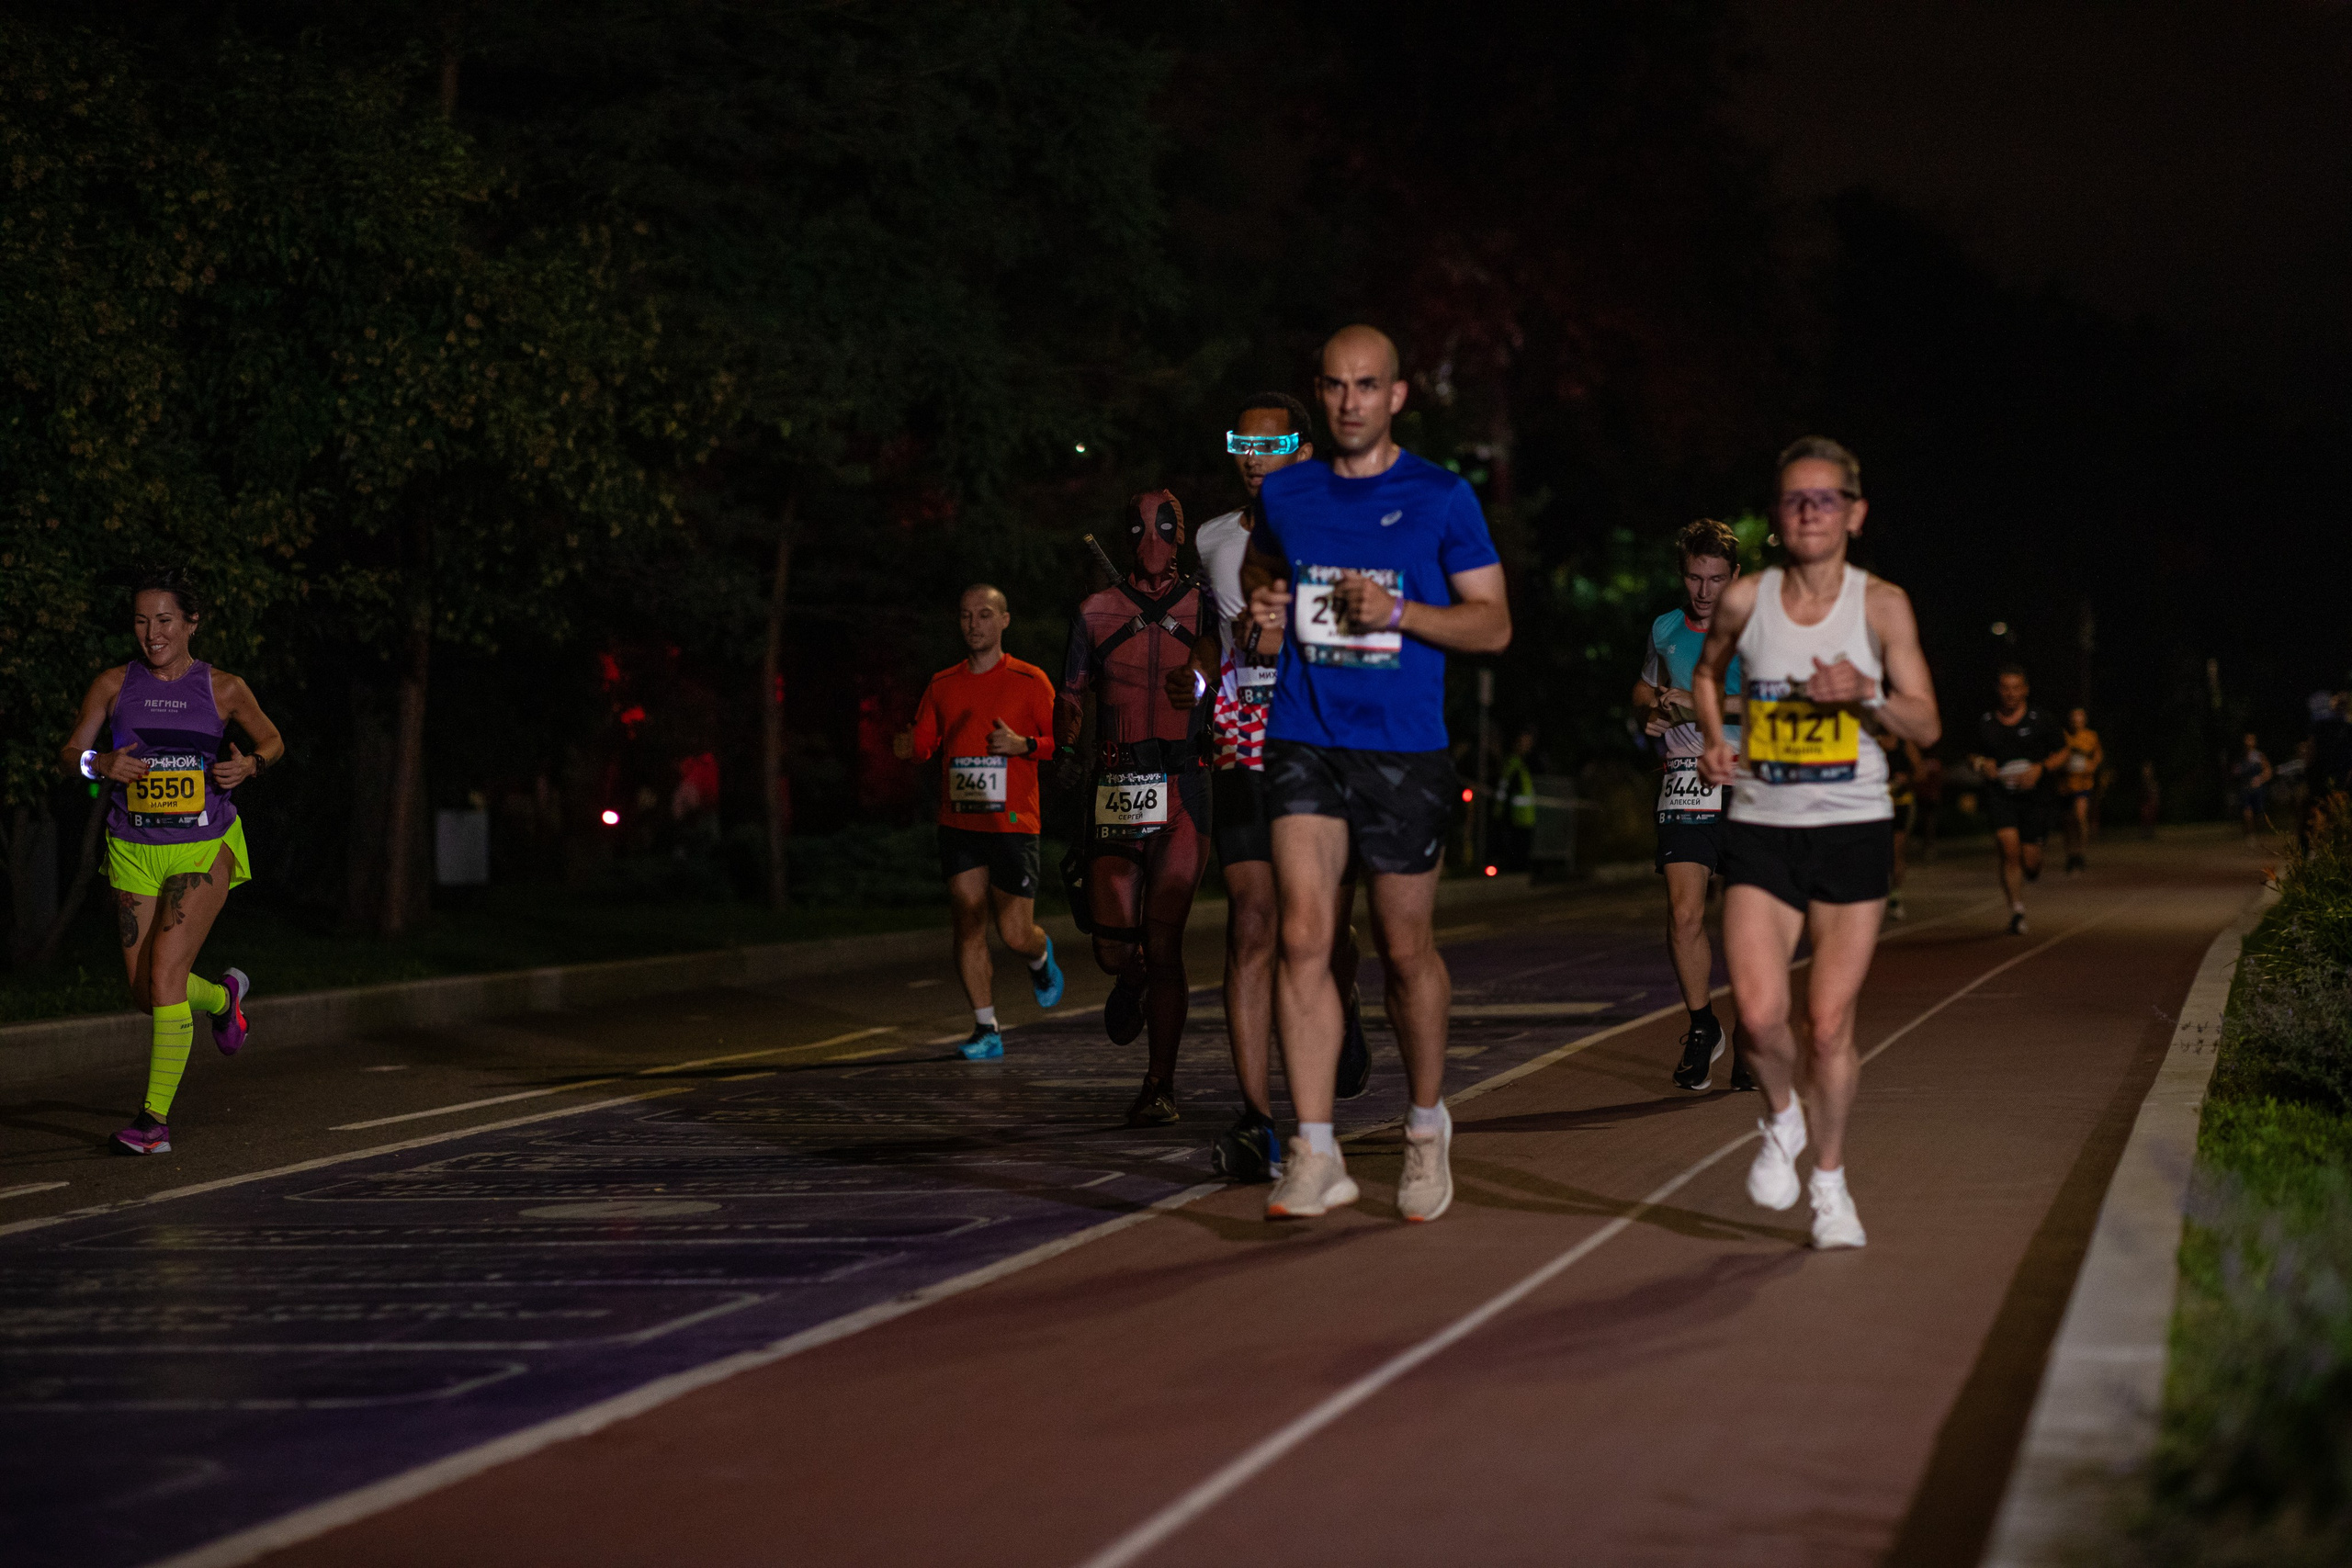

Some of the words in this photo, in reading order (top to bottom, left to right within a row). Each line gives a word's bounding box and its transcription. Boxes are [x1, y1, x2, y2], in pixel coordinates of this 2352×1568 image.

[144, 699, 187, 709] ЛЕГИОН
[1766, 709, 1839, 741] 1121
[1667, 759, 1698, 770] НОЧН
[137, 777, 194, 799] 5550
[956, 773, 997, 790] 2461
[1105, 789, 1158, 813] 4548
[1669, 798, 1701, 807] АЛЕКСЕЙ
[1119, 812, 1143, 820] СЕРГЕЙ
